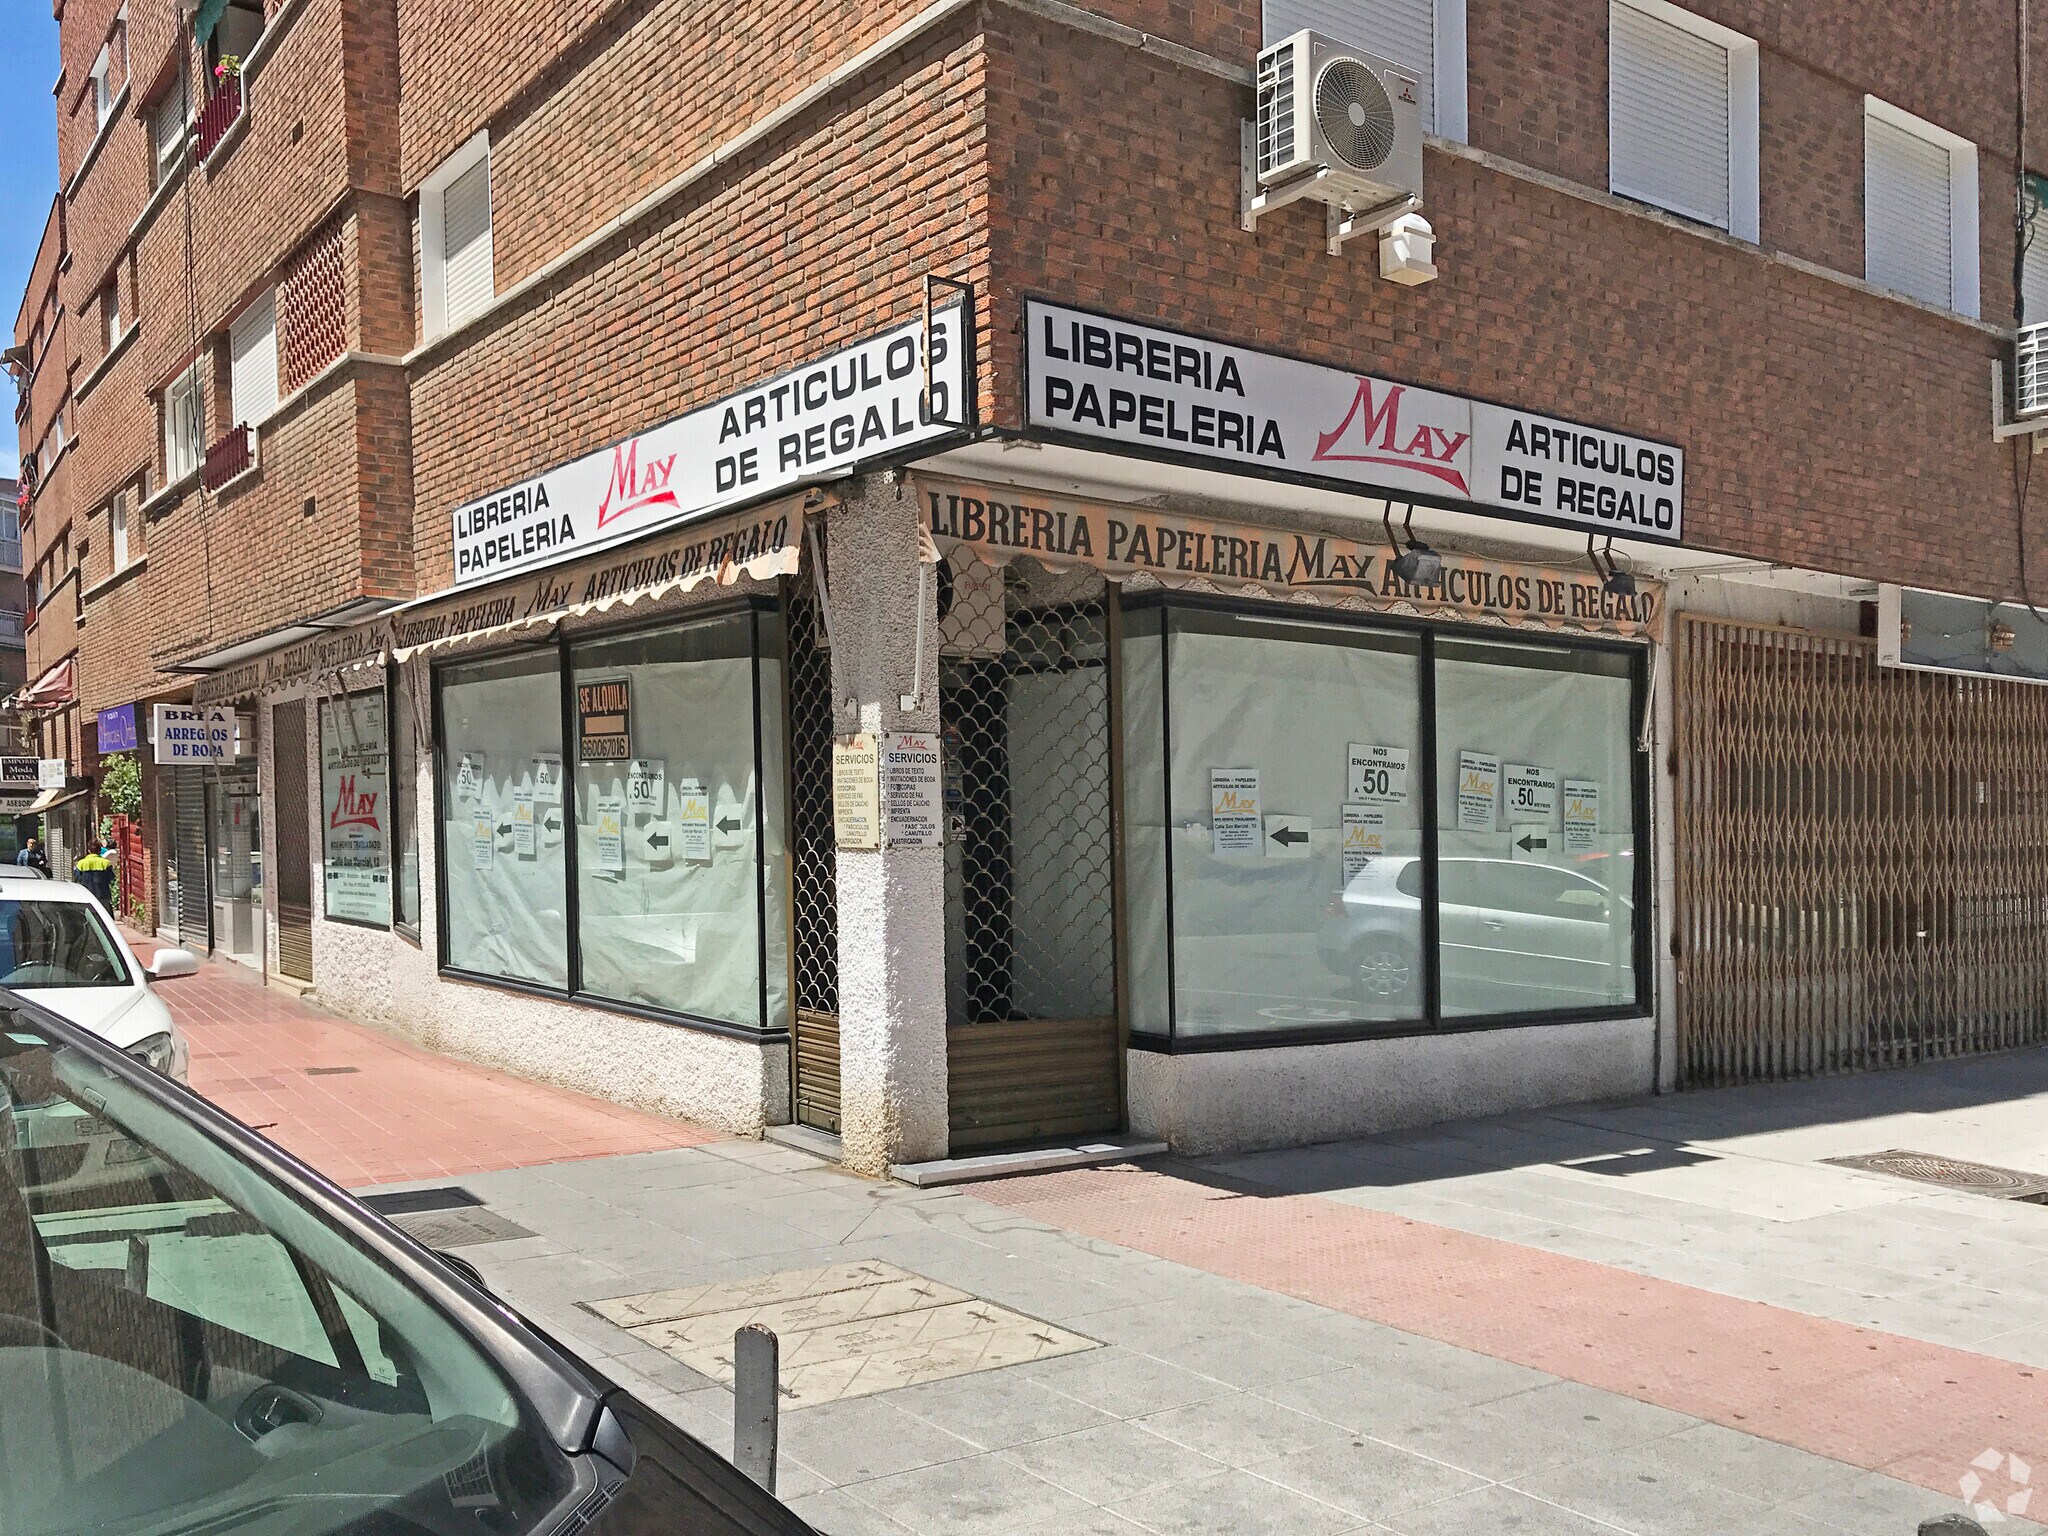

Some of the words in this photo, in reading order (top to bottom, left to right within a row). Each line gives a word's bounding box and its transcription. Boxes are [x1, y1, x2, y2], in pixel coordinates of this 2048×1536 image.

[1044, 315, 1245, 398] LIBRERIA
[719, 322, 947, 444] ARTICULOS
[1045, 375, 1286, 460] PAPELERIA
[715, 447, 758, 493] DE
[779, 381, 949, 473] REGALO
[1505, 419, 1674, 486] ARTICULOS
[458, 482, 550, 539] LIBRERIA
[1501, 465, 1542, 506] DE
[1556, 477, 1673, 530] REGALO
[459, 513, 575, 574] PAPELERIA
[927, 491, 1094, 558] LIBRERIA
[1107, 519, 1284, 583] PAPELERIA
[1537, 578, 1565, 615] DE
[399, 614, 447, 648] LIBRERIA
[448, 596, 516, 637] PAPELERIA
[581, 550, 680, 606] ARTICULOS
[679, 541, 707, 580] DE
[580, 687, 590, 713] SE
[592, 684, 628, 714] ALQUILA
[165, 727, 228, 741] ARREGOS
[173, 744, 188, 756] DE
[582, 738, 625, 758] 660067016
[836, 754, 874, 764] SERVICIOS
[889, 753, 937, 763] SERVICIOS
[1373, 748, 1387, 756] NOS
[1352, 758, 1405, 770] ENCONTRAMOS
[461, 770, 472, 785] 50
[634, 781, 650, 799] 50
[1363, 769, 1389, 795] 50
[1508, 778, 1555, 789] ENCONTRAMOS
[1518, 788, 1533, 806] 50
